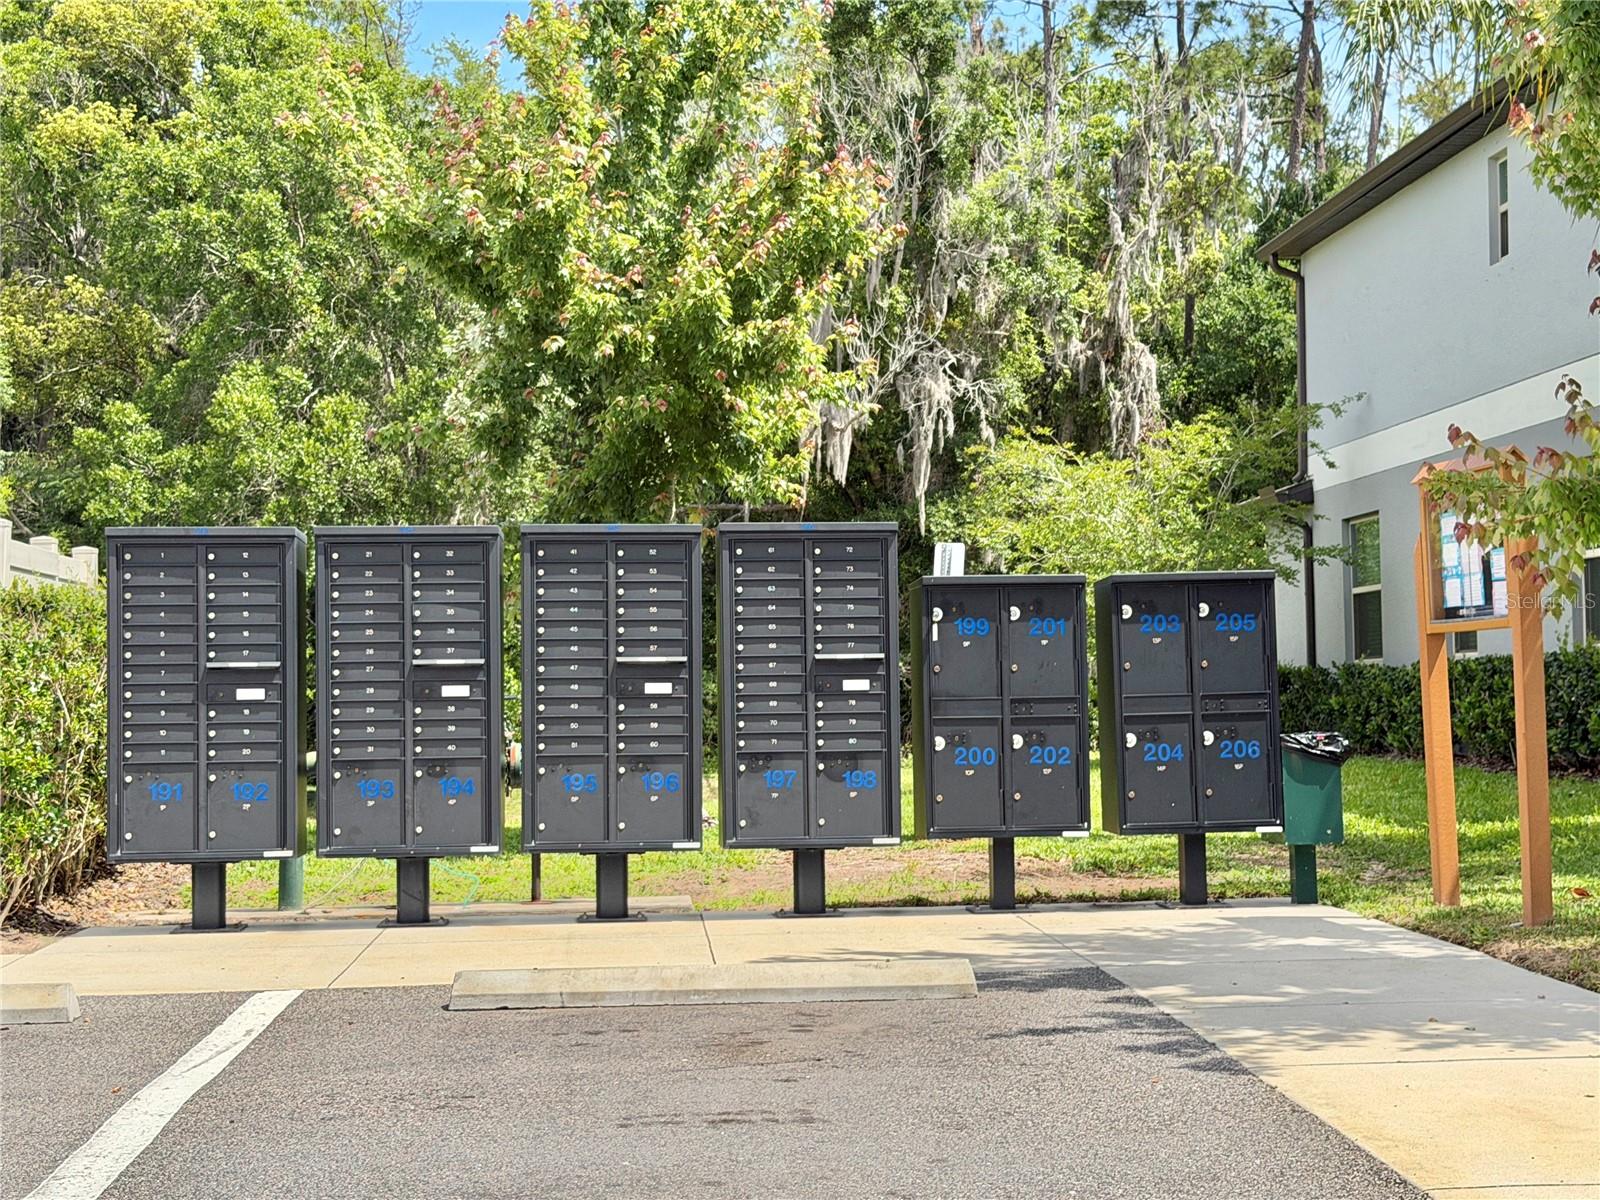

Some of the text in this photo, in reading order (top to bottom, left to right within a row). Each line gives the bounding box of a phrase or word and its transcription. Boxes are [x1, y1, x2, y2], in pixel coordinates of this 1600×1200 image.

[954, 617, 990, 638] 199
[1028, 617, 1066, 639] 201
[1140, 614, 1181, 635] 203
[1216, 613, 1257, 633] 205
[954, 746, 997, 767] 200
[1029, 745, 1072, 767] 202
[1143, 743, 1184, 763] 204
[1219, 740, 1261, 760] 206
[356, 779, 396, 800] 193
[439, 776, 475, 799] 194
[561, 773, 599, 794] 195
[641, 772, 680, 793] 196
[763, 769, 797, 790] 197
[843, 769, 878, 790] 198
[148, 782, 183, 802] 191
[230, 782, 269, 802] 192
